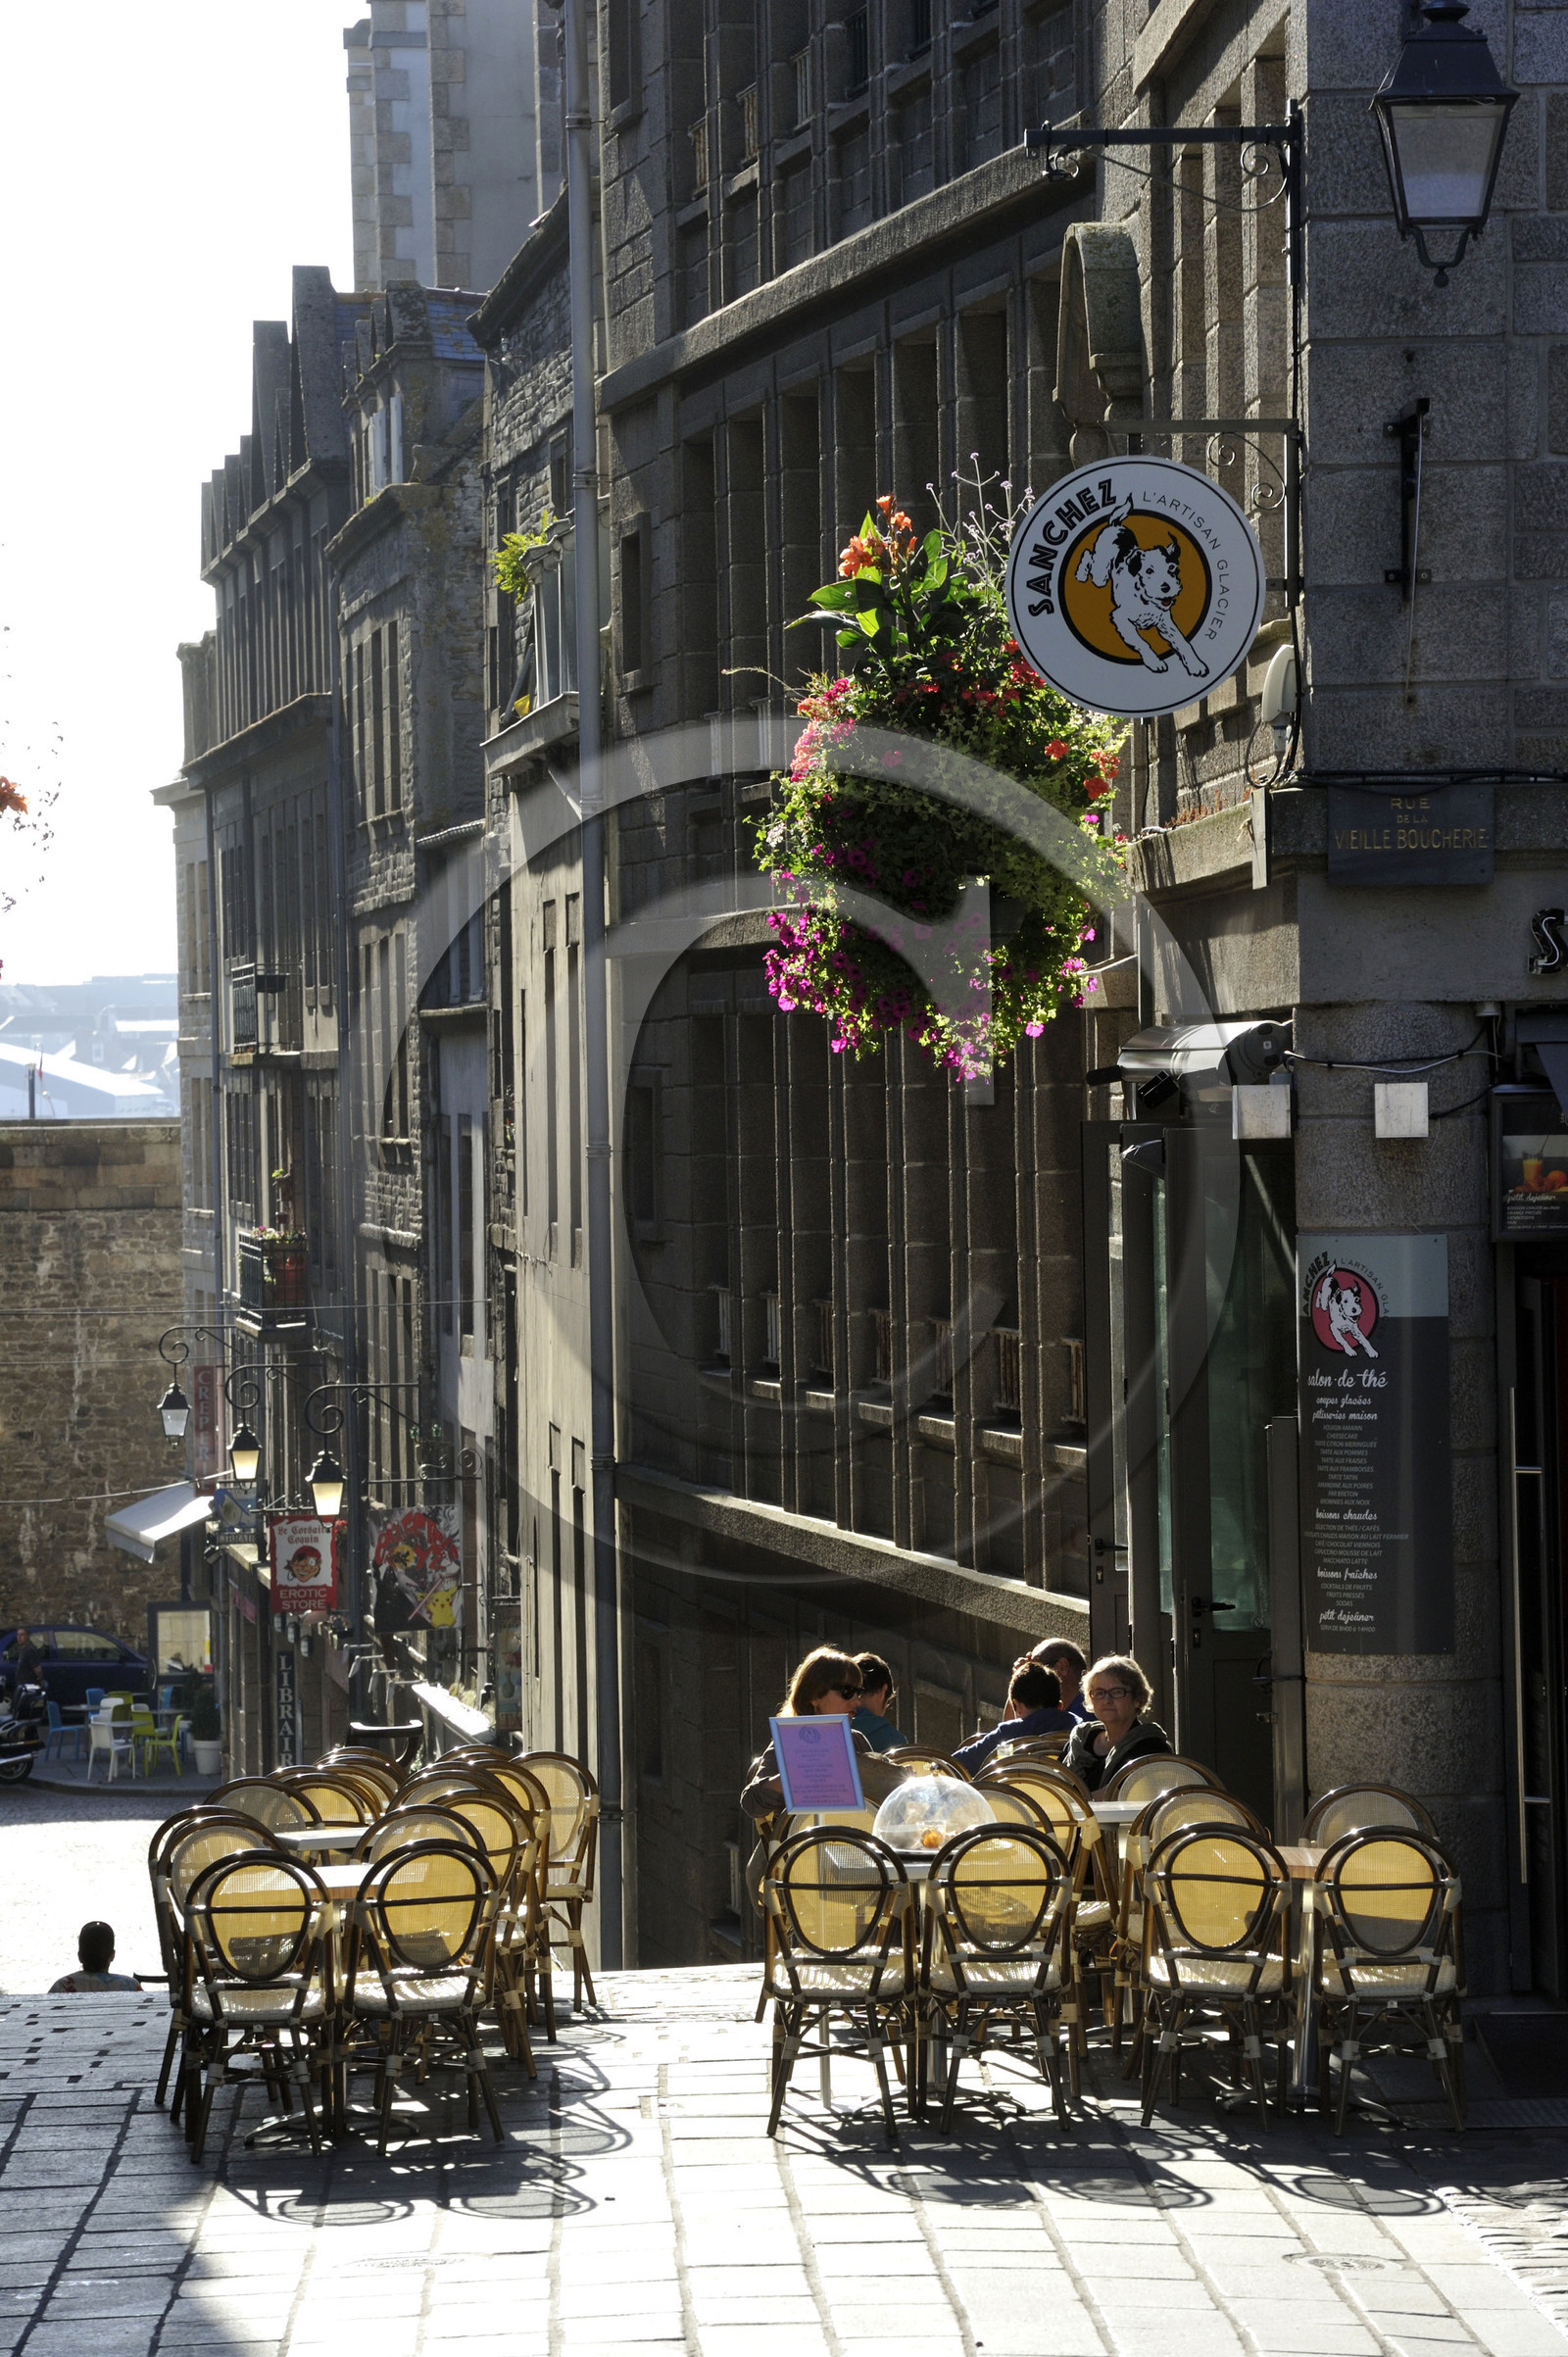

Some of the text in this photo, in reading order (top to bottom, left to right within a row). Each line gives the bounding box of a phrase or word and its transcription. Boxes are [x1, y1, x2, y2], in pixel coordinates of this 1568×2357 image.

[1026, 478, 1116, 617] SANCHEZ
[1143, 491, 1230, 640] L'ARTISAN GLACIER
[1390, 798, 1431, 810] RUE
[1396, 814, 1429, 824] DE LA
[1334, 828, 1489, 850] VIEILLE BOUCHERIE
[1341, 1257, 1384, 1291] L'ARTISAN
[1302, 1251, 1330, 1317] ANCHEZ
[1307, 1367, 1388, 1388] salon de thé
[1316, 1394, 1372, 1408] coupes glacées
[1348, 1410, 1378, 1420] maison
[1343, 1509, 1378, 1521] chaudes
[277, 1525, 288, 1536] Le
[287, 1534, 319, 1545] Coquin
[1344, 1567, 1378, 1581] fraîches
[279, 1588, 327, 1599] EROTIC
[281, 1598, 326, 1610] STORE
[1319, 1608, 1337, 1624] petit
